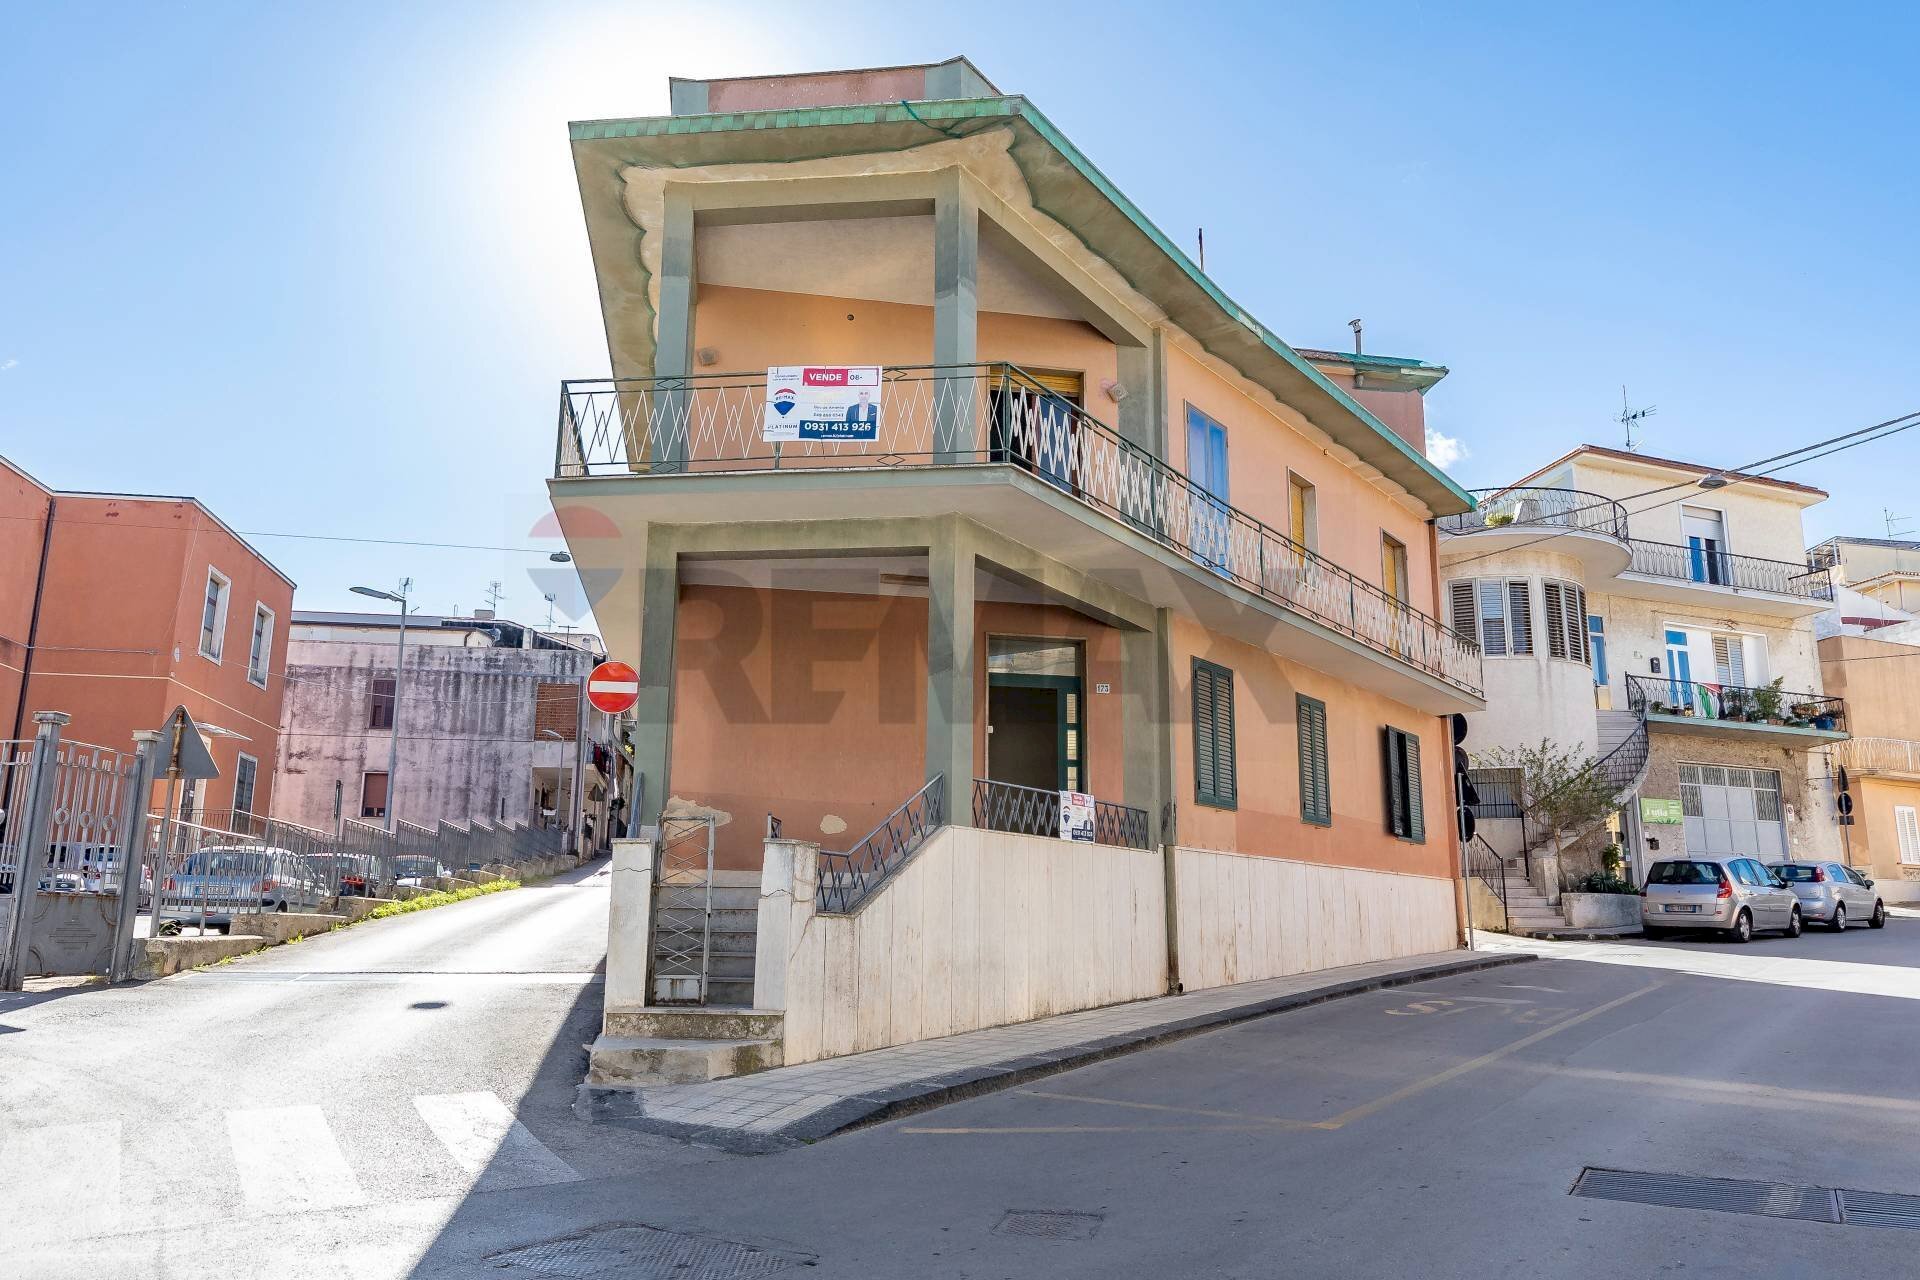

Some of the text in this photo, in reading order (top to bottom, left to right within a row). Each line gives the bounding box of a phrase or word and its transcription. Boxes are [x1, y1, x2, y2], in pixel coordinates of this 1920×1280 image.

[809, 373, 842, 381] VENDE
[804, 422, 872, 431] 0931 413 926
